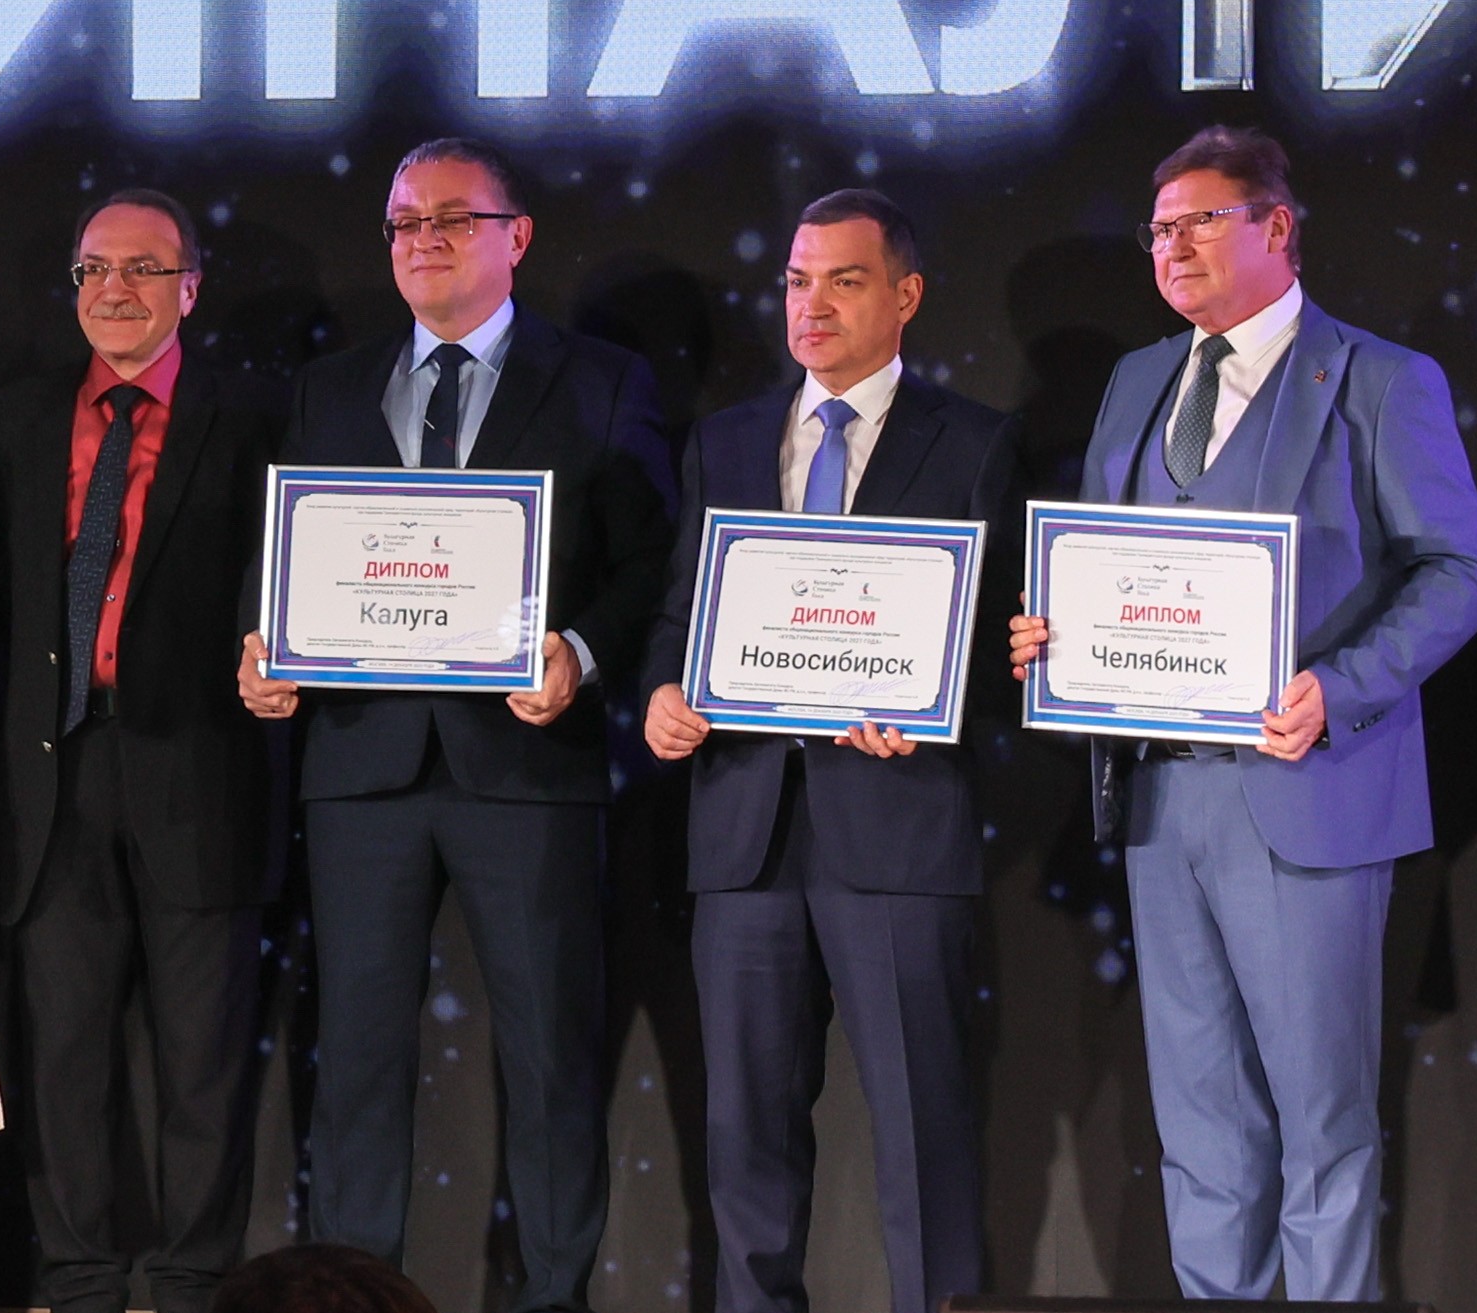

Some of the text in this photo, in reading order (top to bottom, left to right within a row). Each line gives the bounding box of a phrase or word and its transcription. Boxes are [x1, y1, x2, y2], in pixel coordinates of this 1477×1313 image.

[364, 561, 449, 579] ДИПЛОМ
[361, 602, 448, 631] Калуга
[791, 607, 876, 626] ДИПЛОМ
[1120, 605, 1201, 625] ДИПЛОМ
[741, 645, 914, 679] Новосибирск
[1092, 645, 1227, 675] Челябинск
